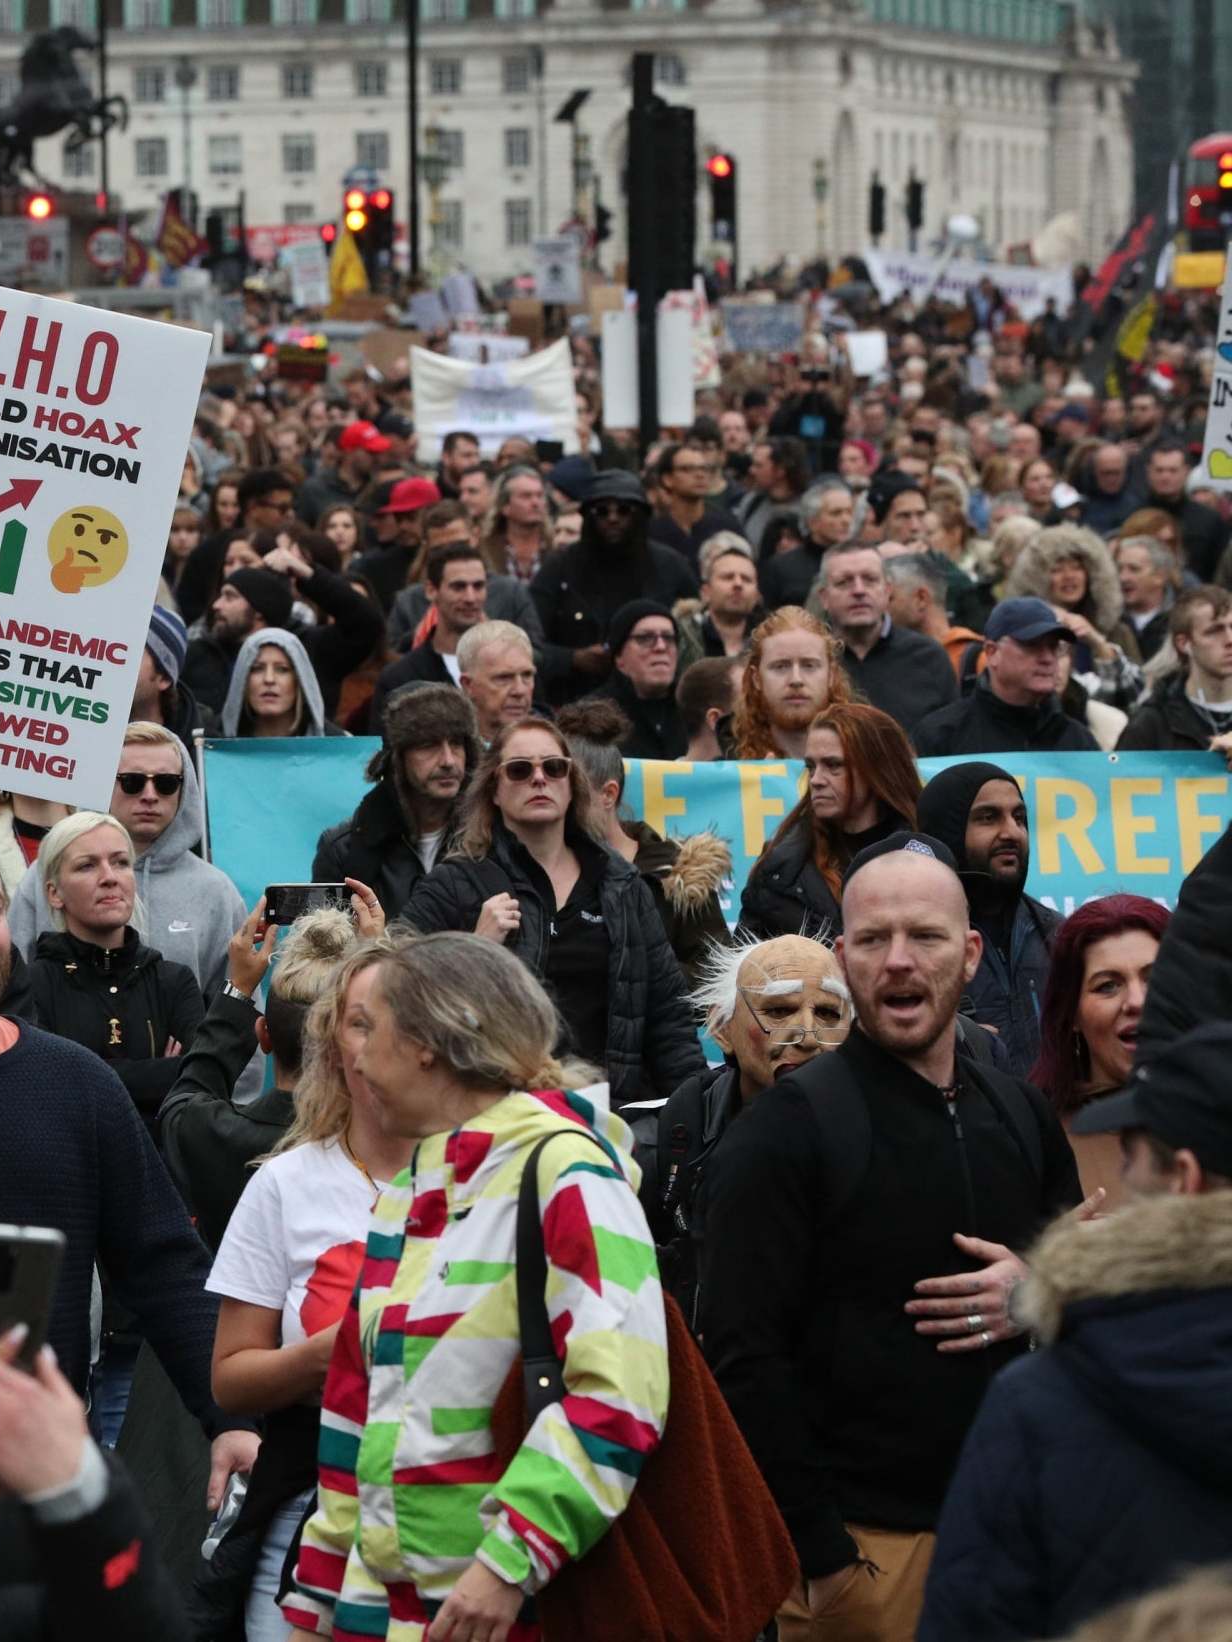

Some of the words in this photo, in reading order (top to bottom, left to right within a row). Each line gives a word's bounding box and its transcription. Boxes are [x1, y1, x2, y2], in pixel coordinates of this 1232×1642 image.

[32, 406, 141, 449] HOAX
[18, 654, 102, 690] THAT
[1016, 774, 1228, 876] REE
